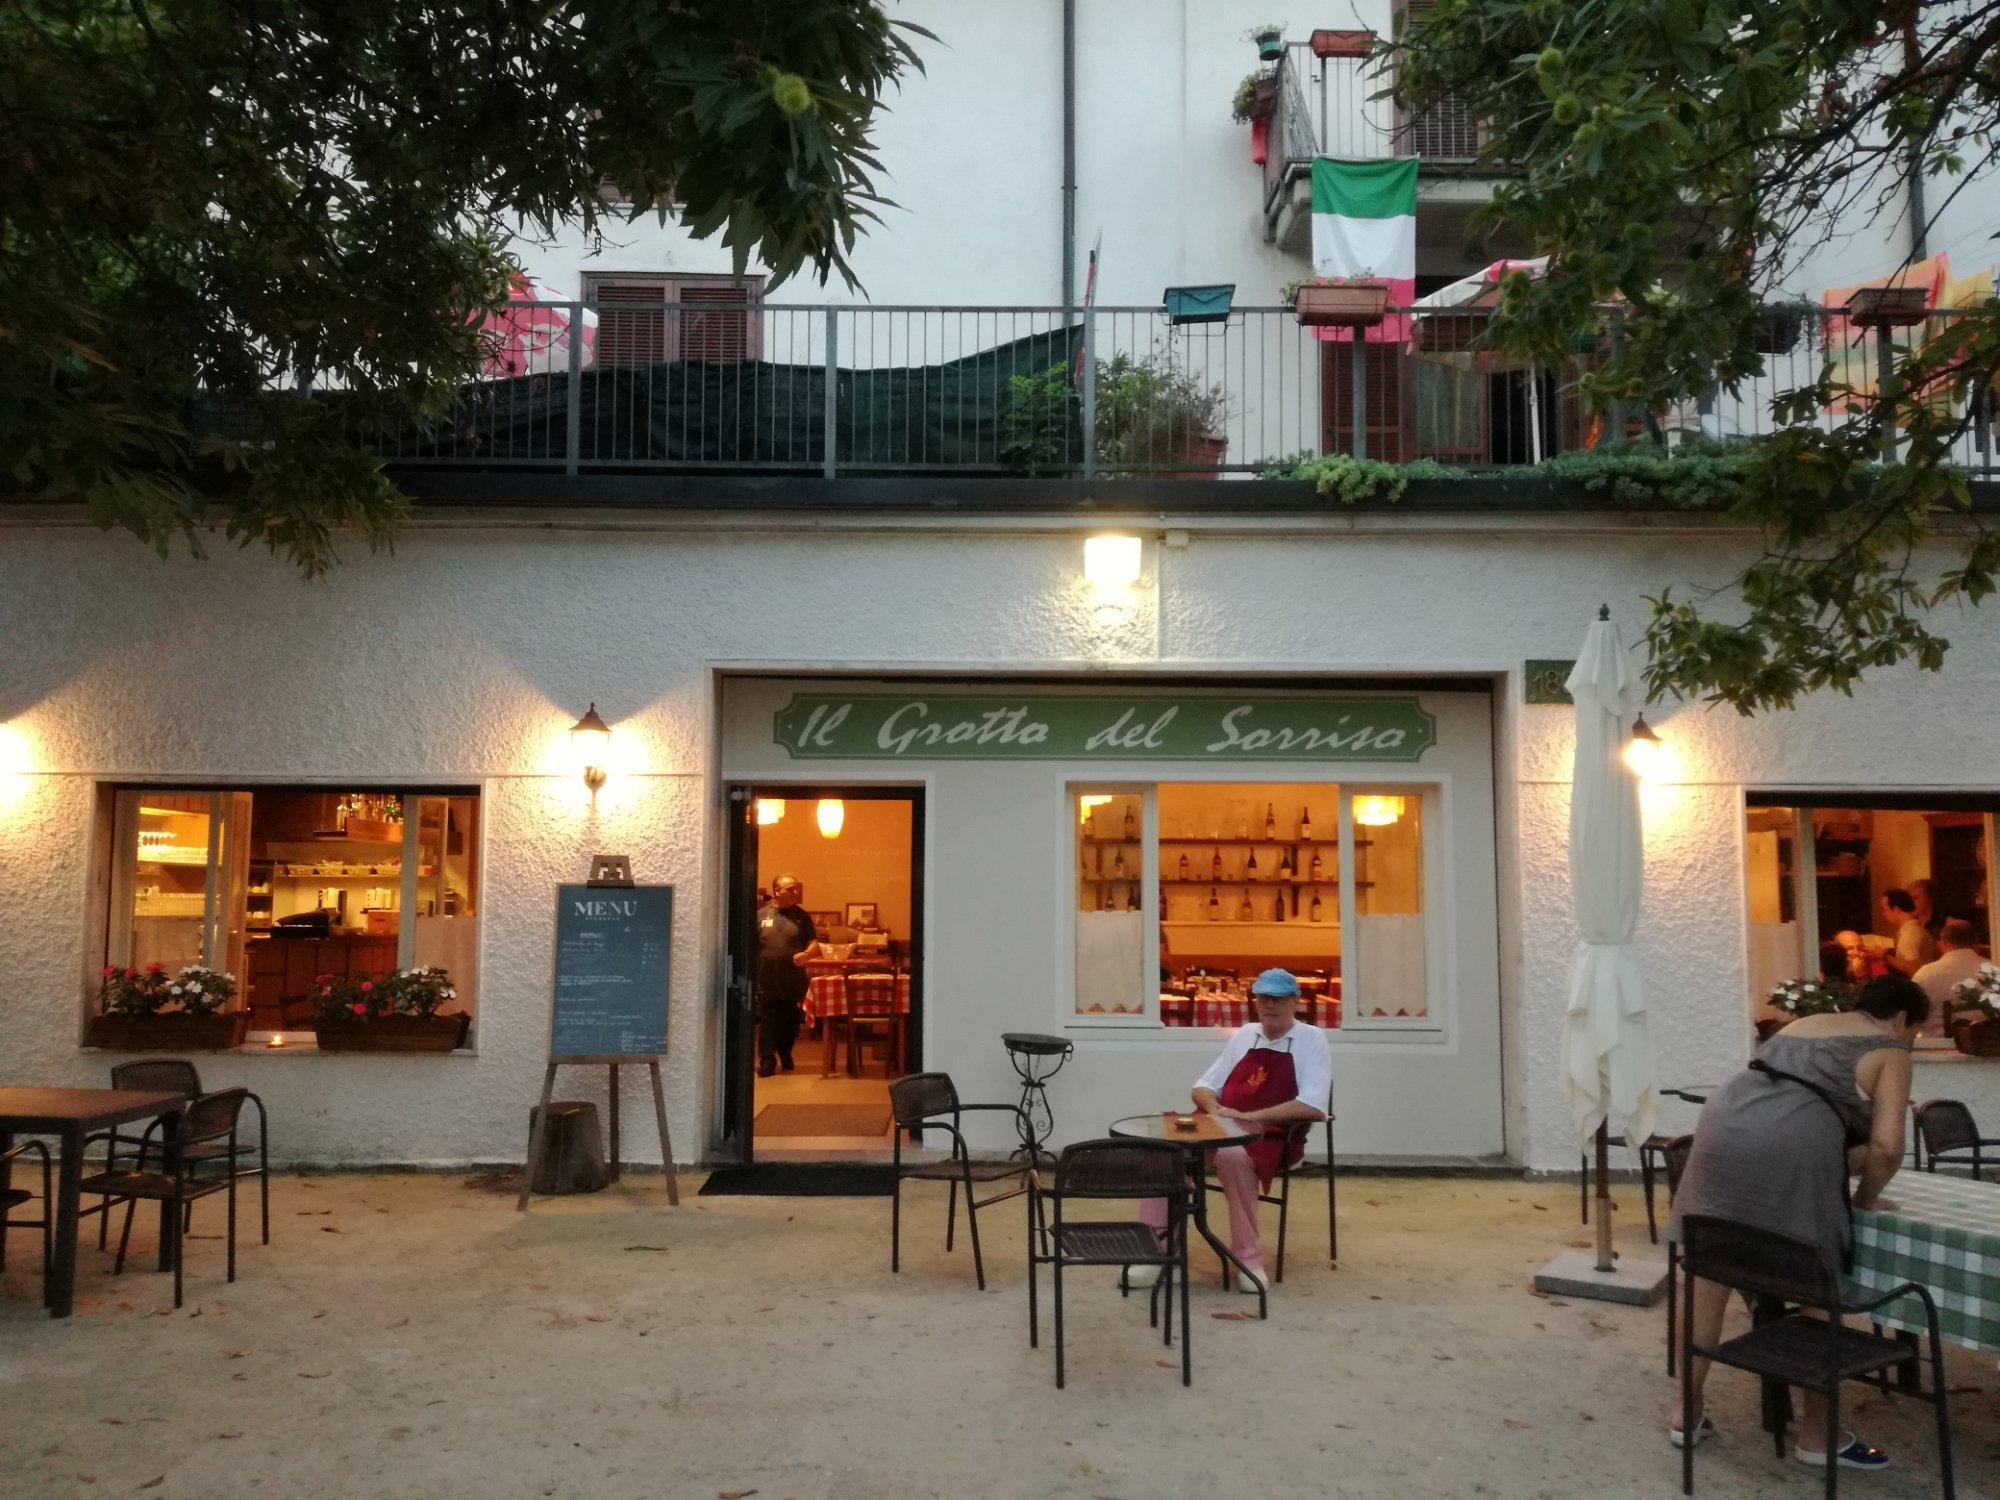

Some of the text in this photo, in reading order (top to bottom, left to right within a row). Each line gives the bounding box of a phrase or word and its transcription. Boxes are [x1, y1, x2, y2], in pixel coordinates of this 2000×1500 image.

[797, 701, 1405, 754] Il Grotto del Sorriso
[574, 901, 637, 917] MENU
